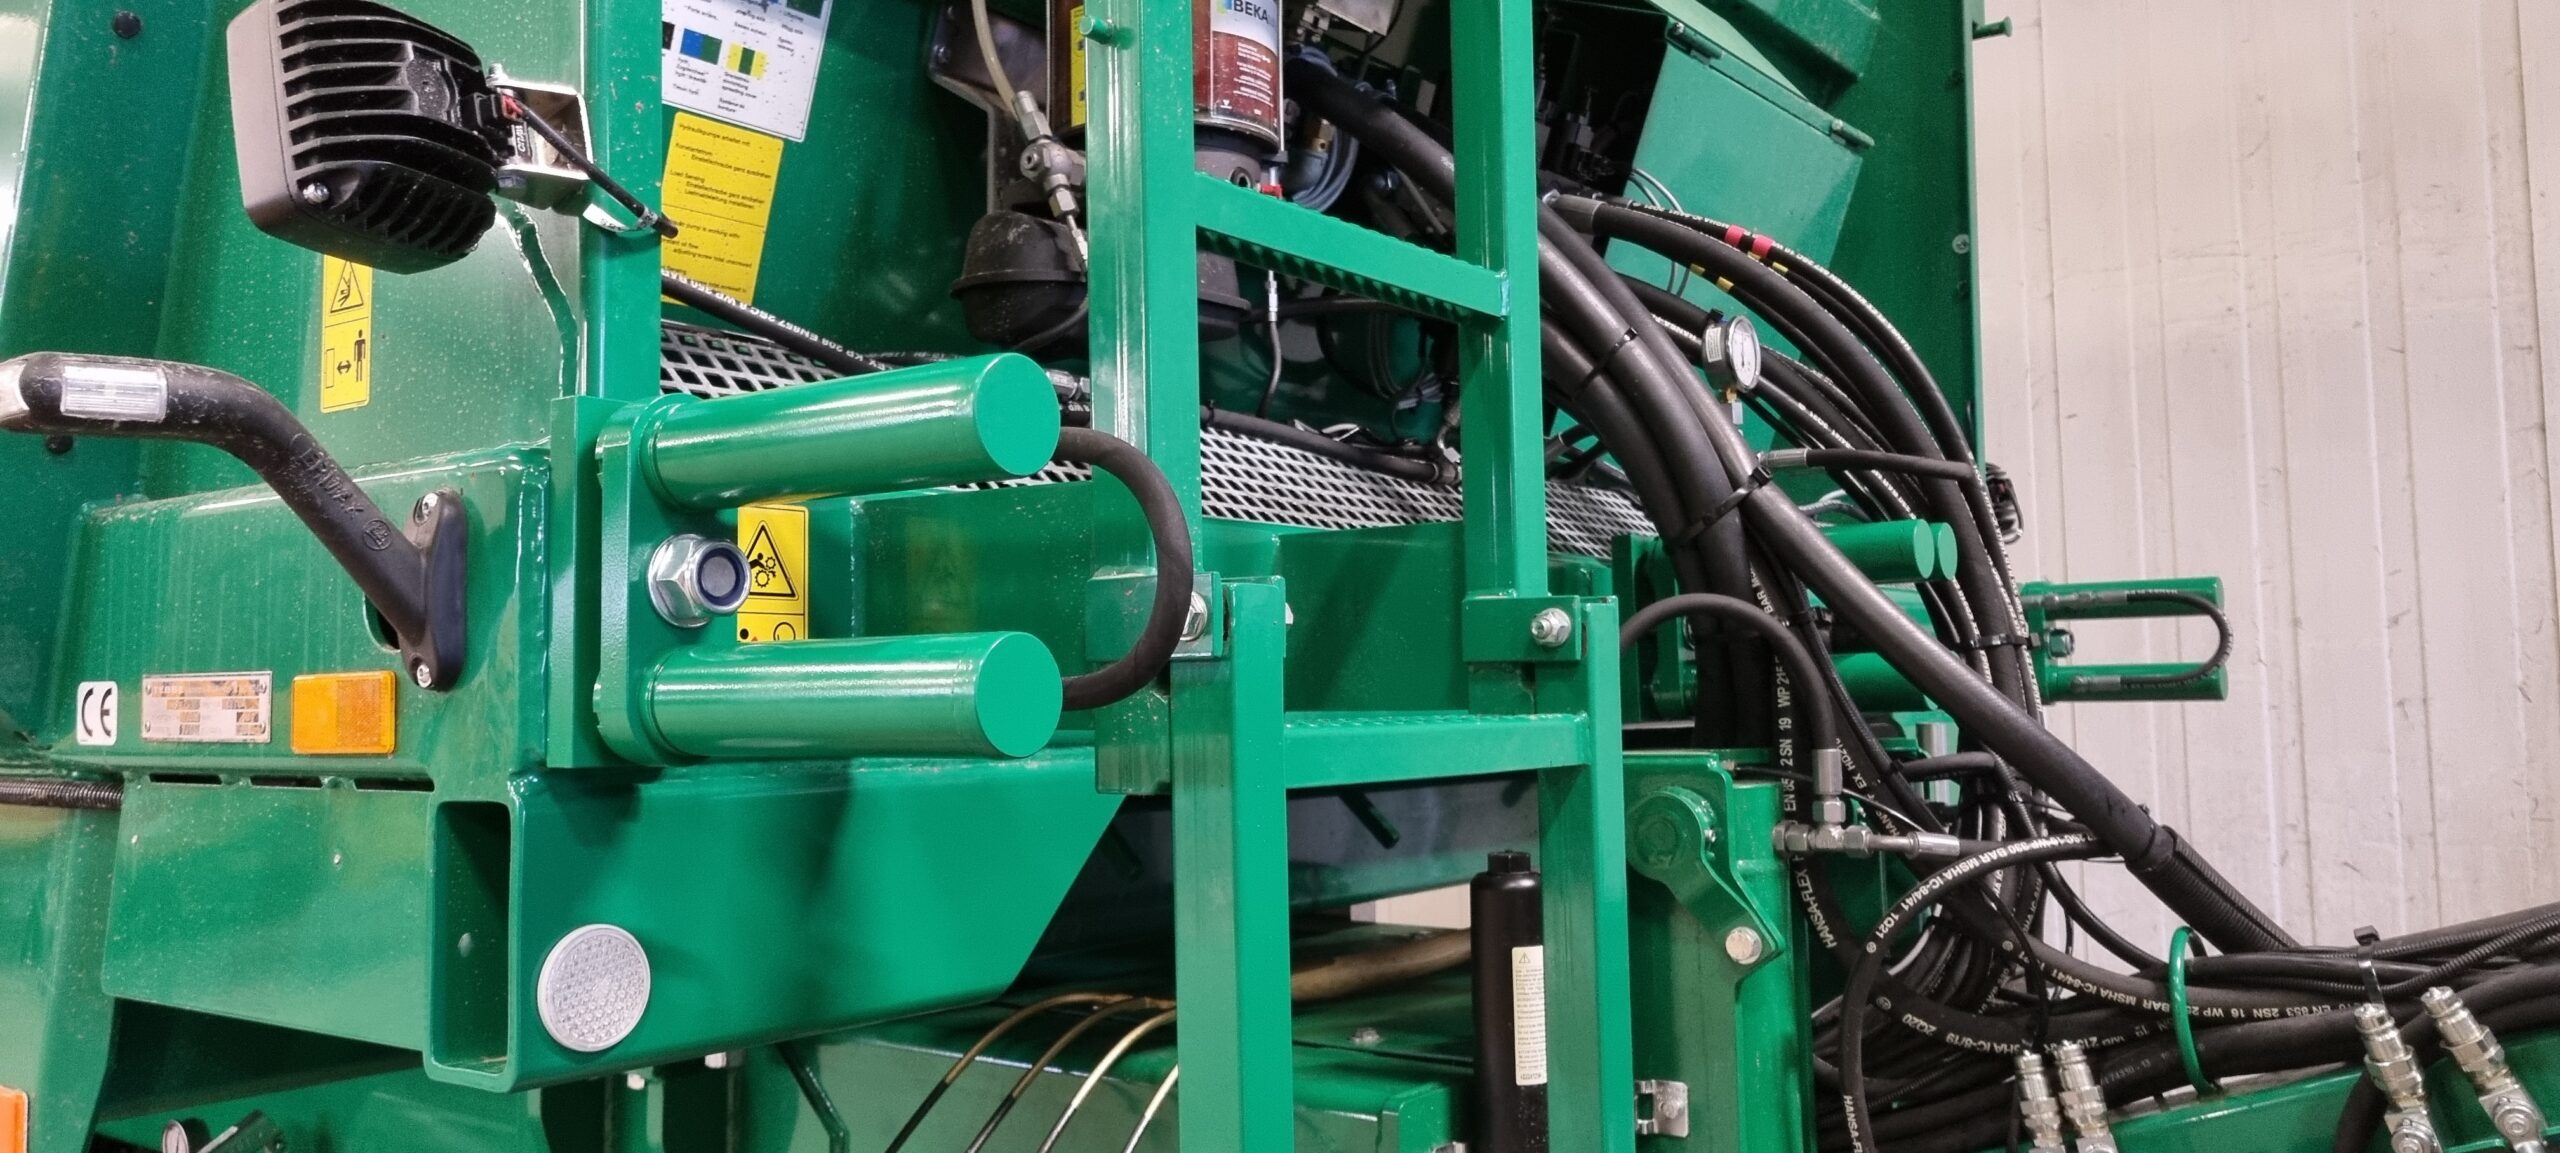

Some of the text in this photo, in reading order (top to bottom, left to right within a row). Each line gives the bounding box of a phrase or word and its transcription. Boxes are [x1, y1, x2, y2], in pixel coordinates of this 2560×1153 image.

[1233, 0, 1269, 25] BEKA
[1757, 591, 1773, 614] BAR
[1777, 687, 1791, 708] WP
[81, 687, 112, 737] CE
[1778, 717, 1792, 731] 19
[1780, 739, 1793, 767] 2SN
[1979, 846, 2008, 865] BAR
[1944, 858, 1980, 881] MSHA
[1900, 876, 1945, 911] IC-84/41
[1794, 868, 1837, 949] HANSA-FLEX
[1875, 913, 1899, 939] 1Q21
[2049, 967, 2099, 993] IC-84/41
[2097, 986, 2137, 1006] MSHA
[2141, 996, 2171, 1014] BAR
[2202, 1006, 2223, 1017] WP
[2230, 1007, 2245, 1017] 16
[2252, 1006, 2279, 1017] 2SN
[1899, 1010, 1938, 1037] 2Q20
[1944, 1027, 1991, 1056] IC-8/19
